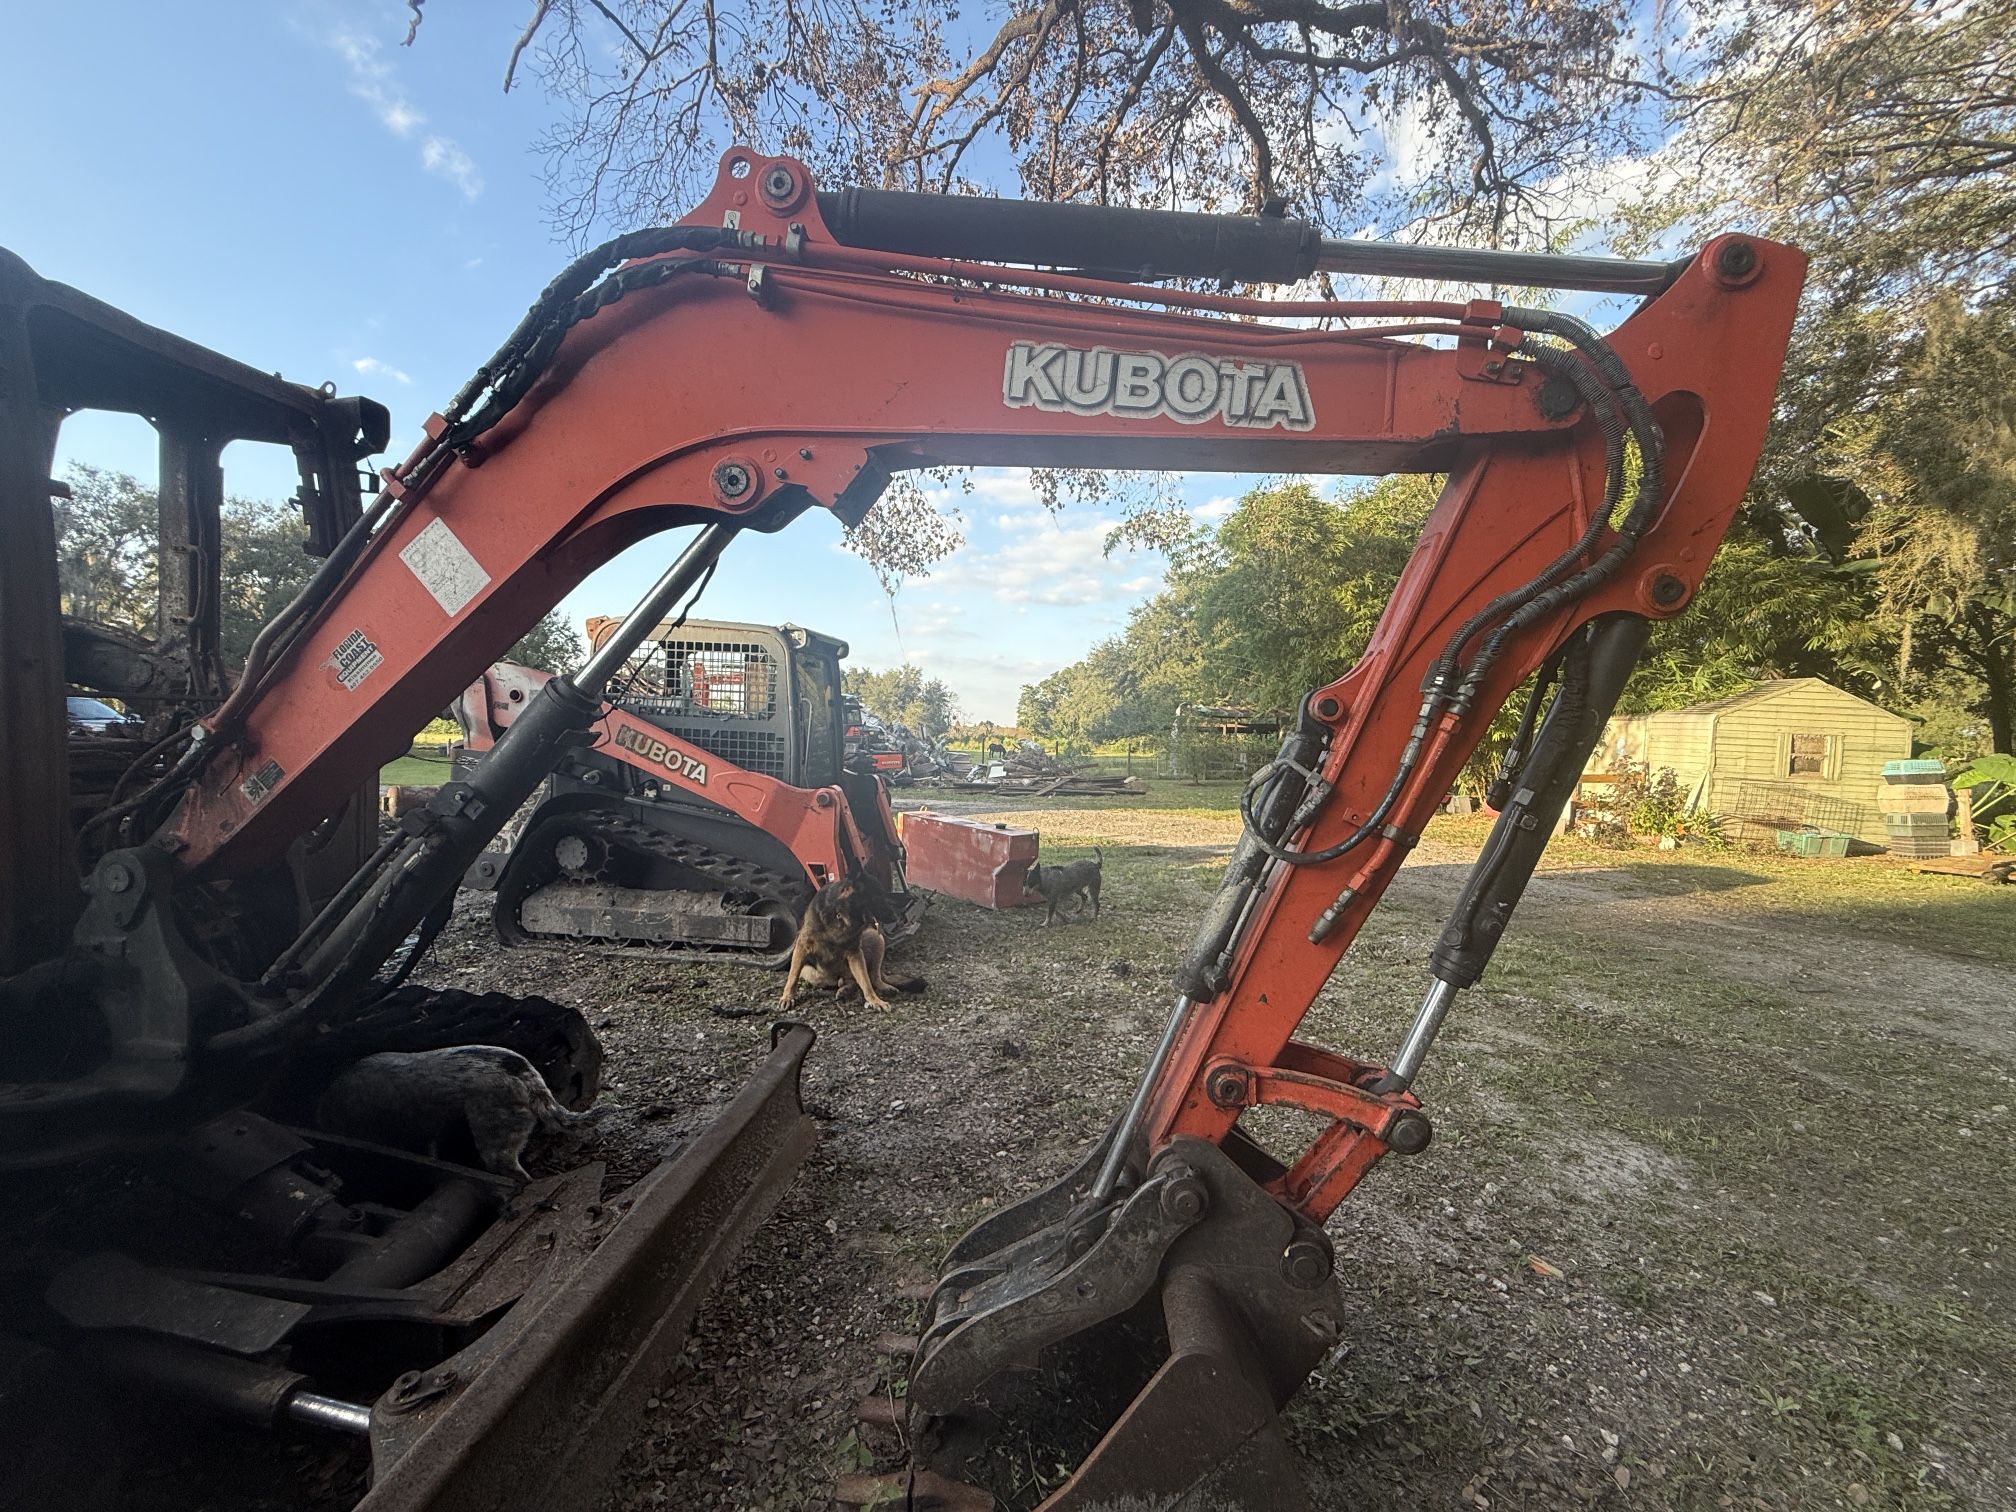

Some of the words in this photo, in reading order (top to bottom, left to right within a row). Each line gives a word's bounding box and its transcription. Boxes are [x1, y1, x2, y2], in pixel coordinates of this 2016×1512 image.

[1008, 344, 1306, 421] KUBOTA
[332, 629, 363, 660] FLORIDA
[340, 637, 369, 668] COAST
[339, 645, 375, 679] EQUIPMENT
[616, 725, 706, 785] KUBOTA
